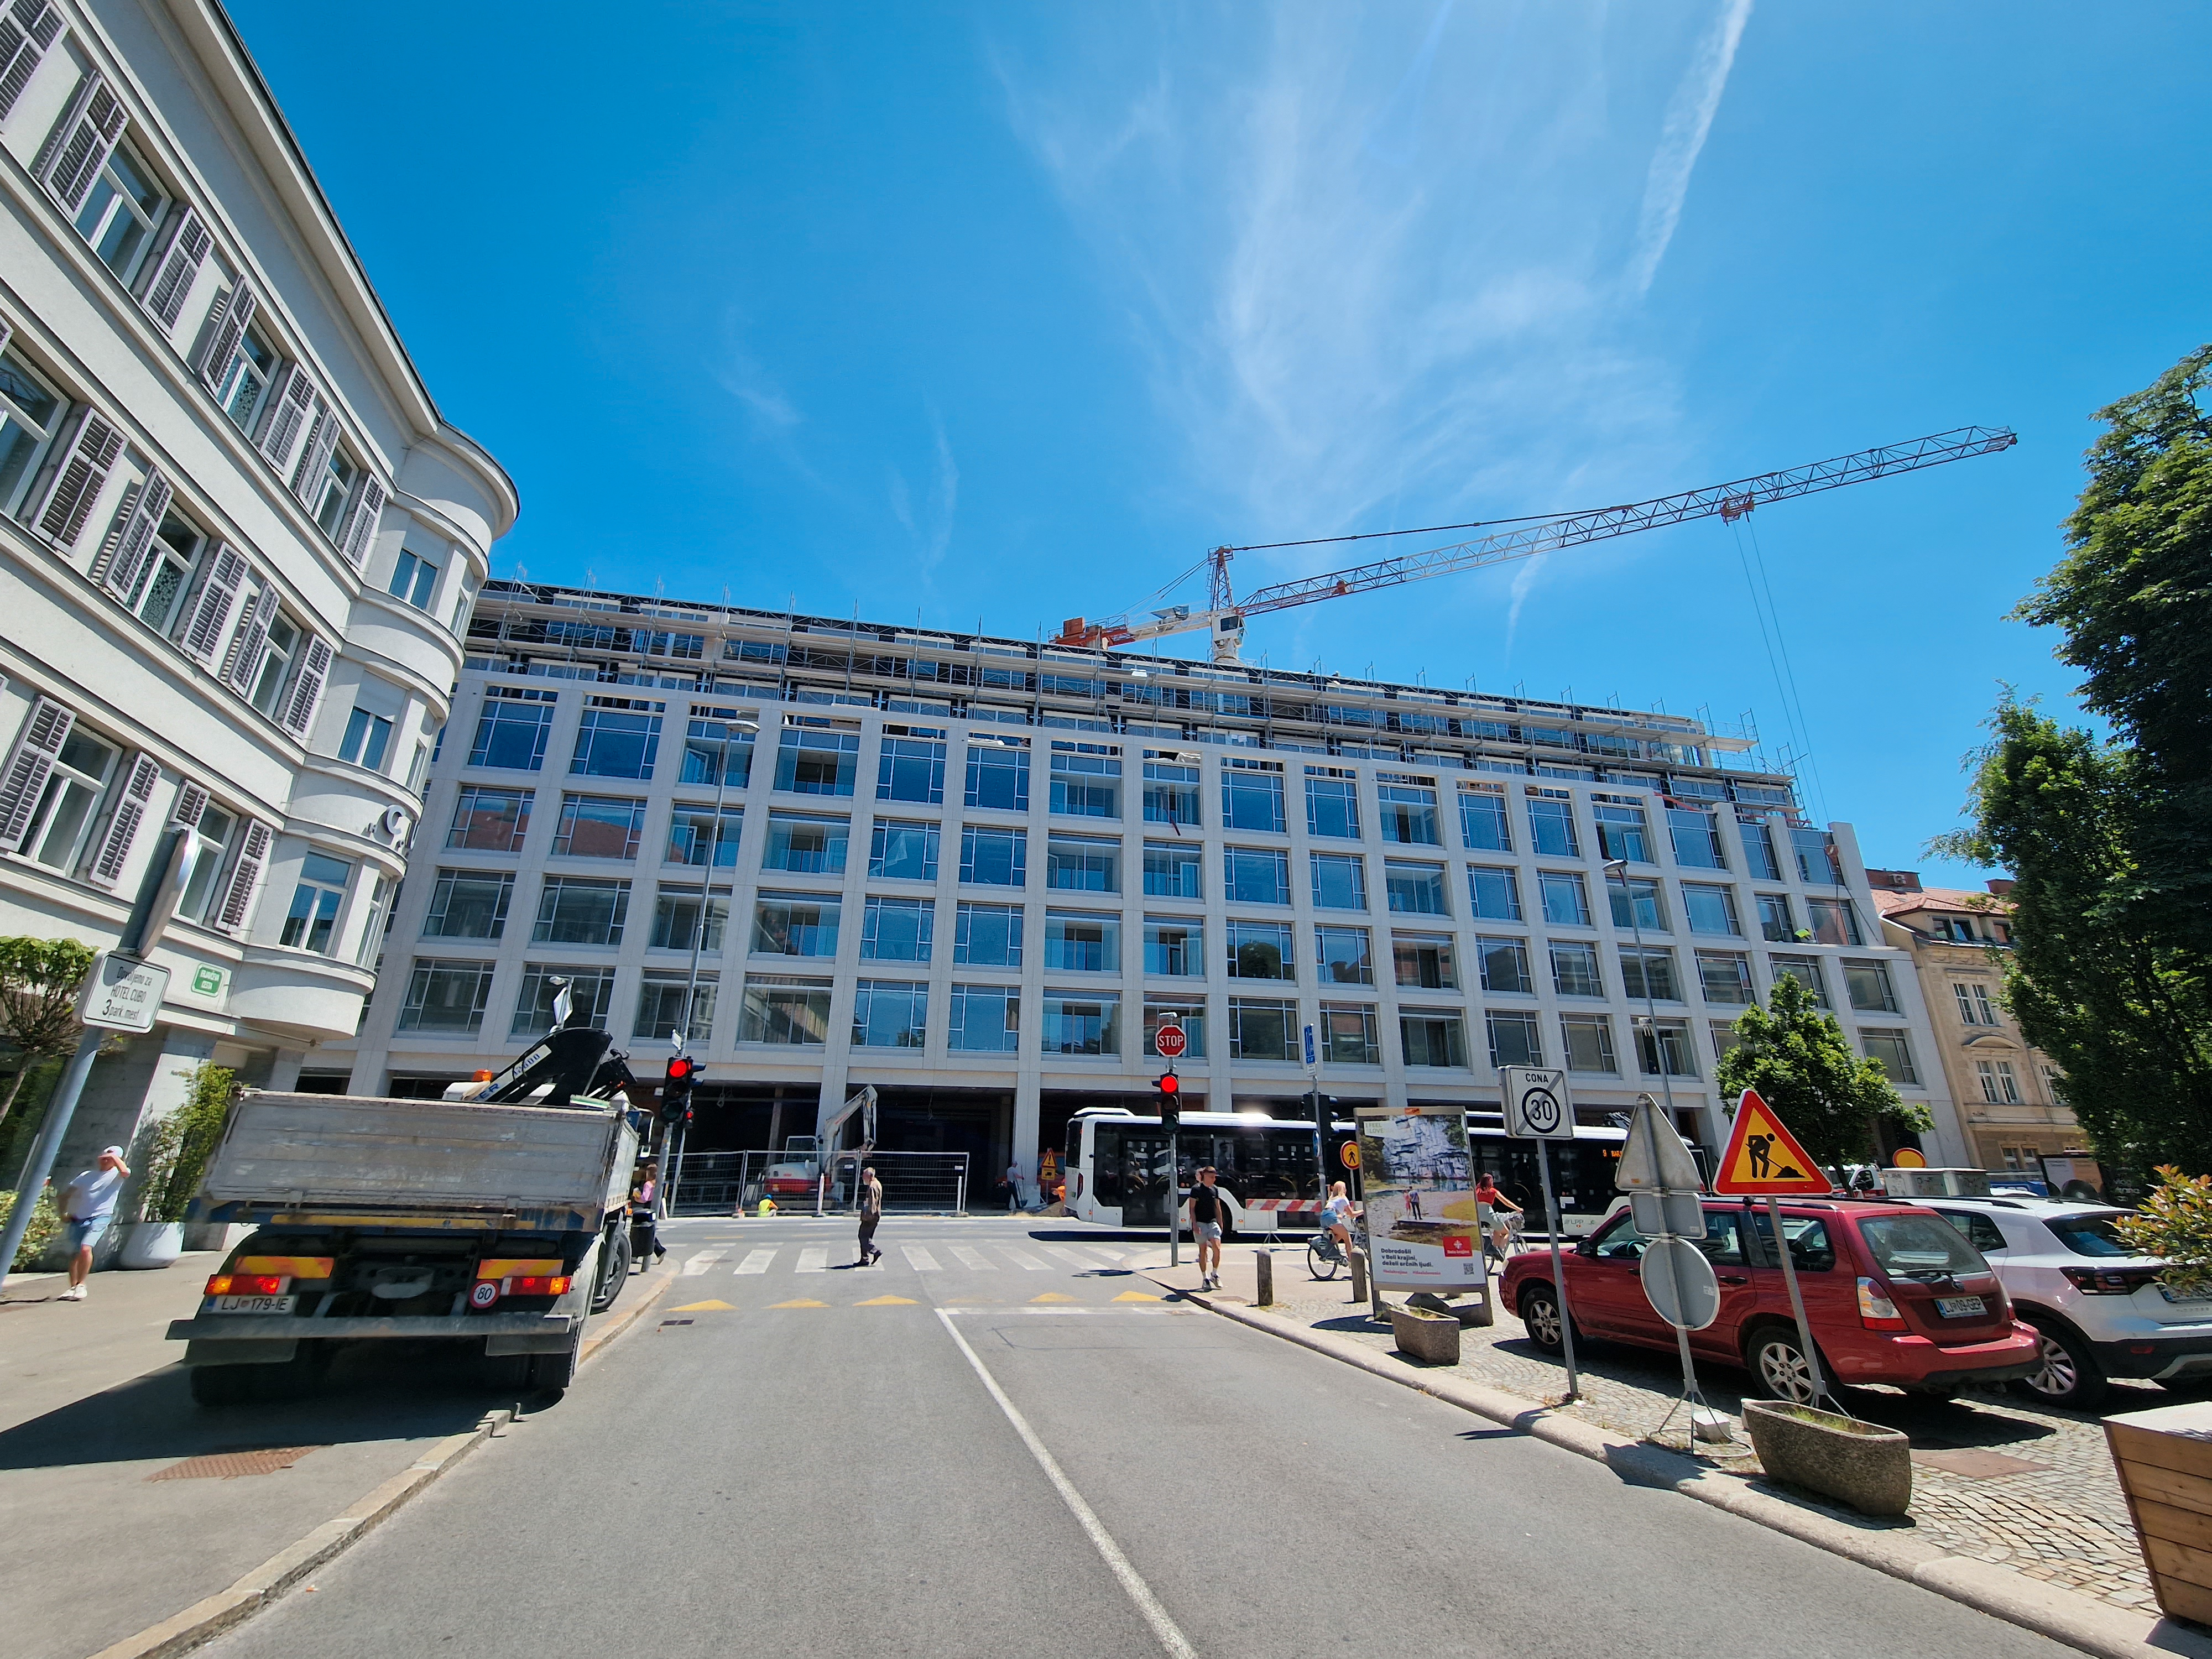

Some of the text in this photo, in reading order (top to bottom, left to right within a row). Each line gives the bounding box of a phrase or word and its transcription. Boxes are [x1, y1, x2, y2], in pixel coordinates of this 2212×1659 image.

[117, 966, 153, 987] Dovoljeno za
[111, 984, 147, 1003] HOTEL CUBO
[102, 999, 112, 1016] 3
[124, 1009, 140, 1020] mest
[1159, 1035, 1183, 1047] STOP
[1525, 1073, 1549, 1083] CONA
[1531, 1099, 1552, 1121] 30
[477, 1287, 492, 1300] 80
